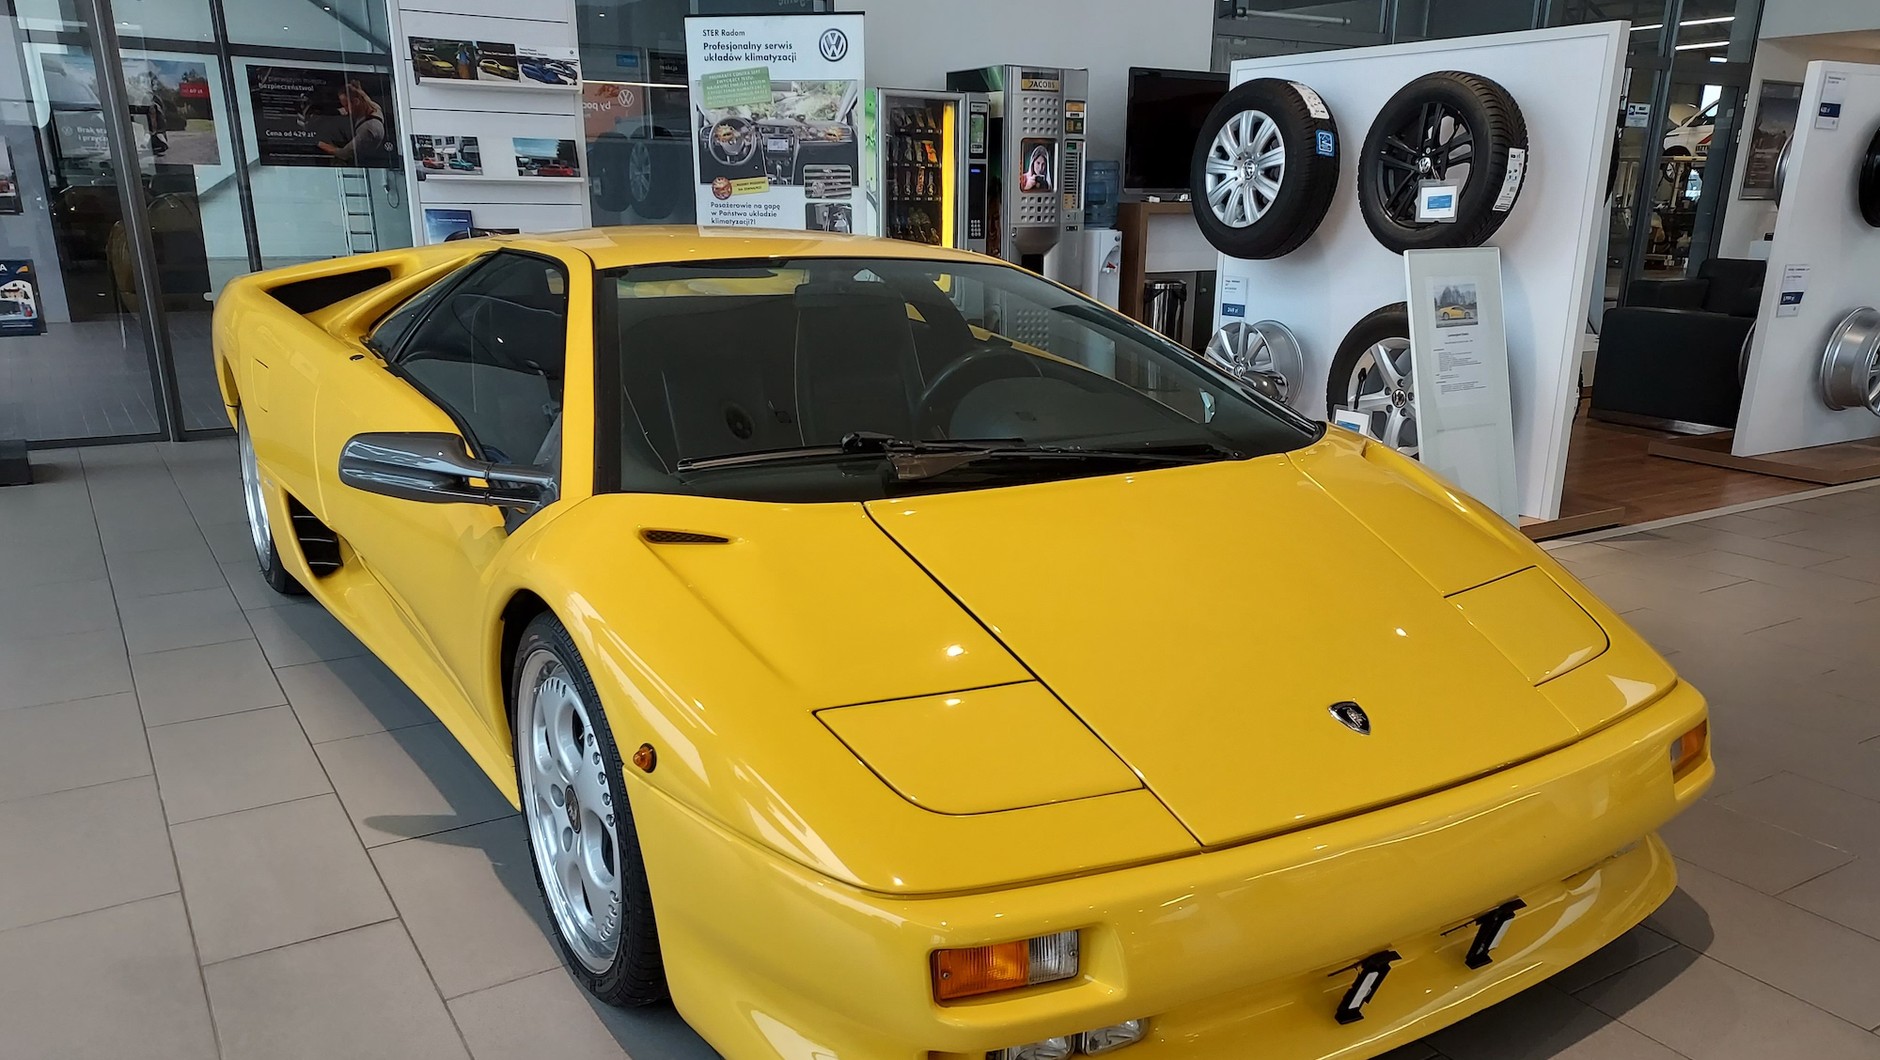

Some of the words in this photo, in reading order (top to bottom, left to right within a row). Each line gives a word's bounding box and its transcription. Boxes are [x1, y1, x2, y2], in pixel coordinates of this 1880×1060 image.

[703, 41, 762, 52] Profesjonalny
[764, 41, 792, 50] serwis
[704, 53, 741, 62] układów
[744, 52, 797, 63] klimatyzacji
[1028, 80, 1055, 88] JACOBS
